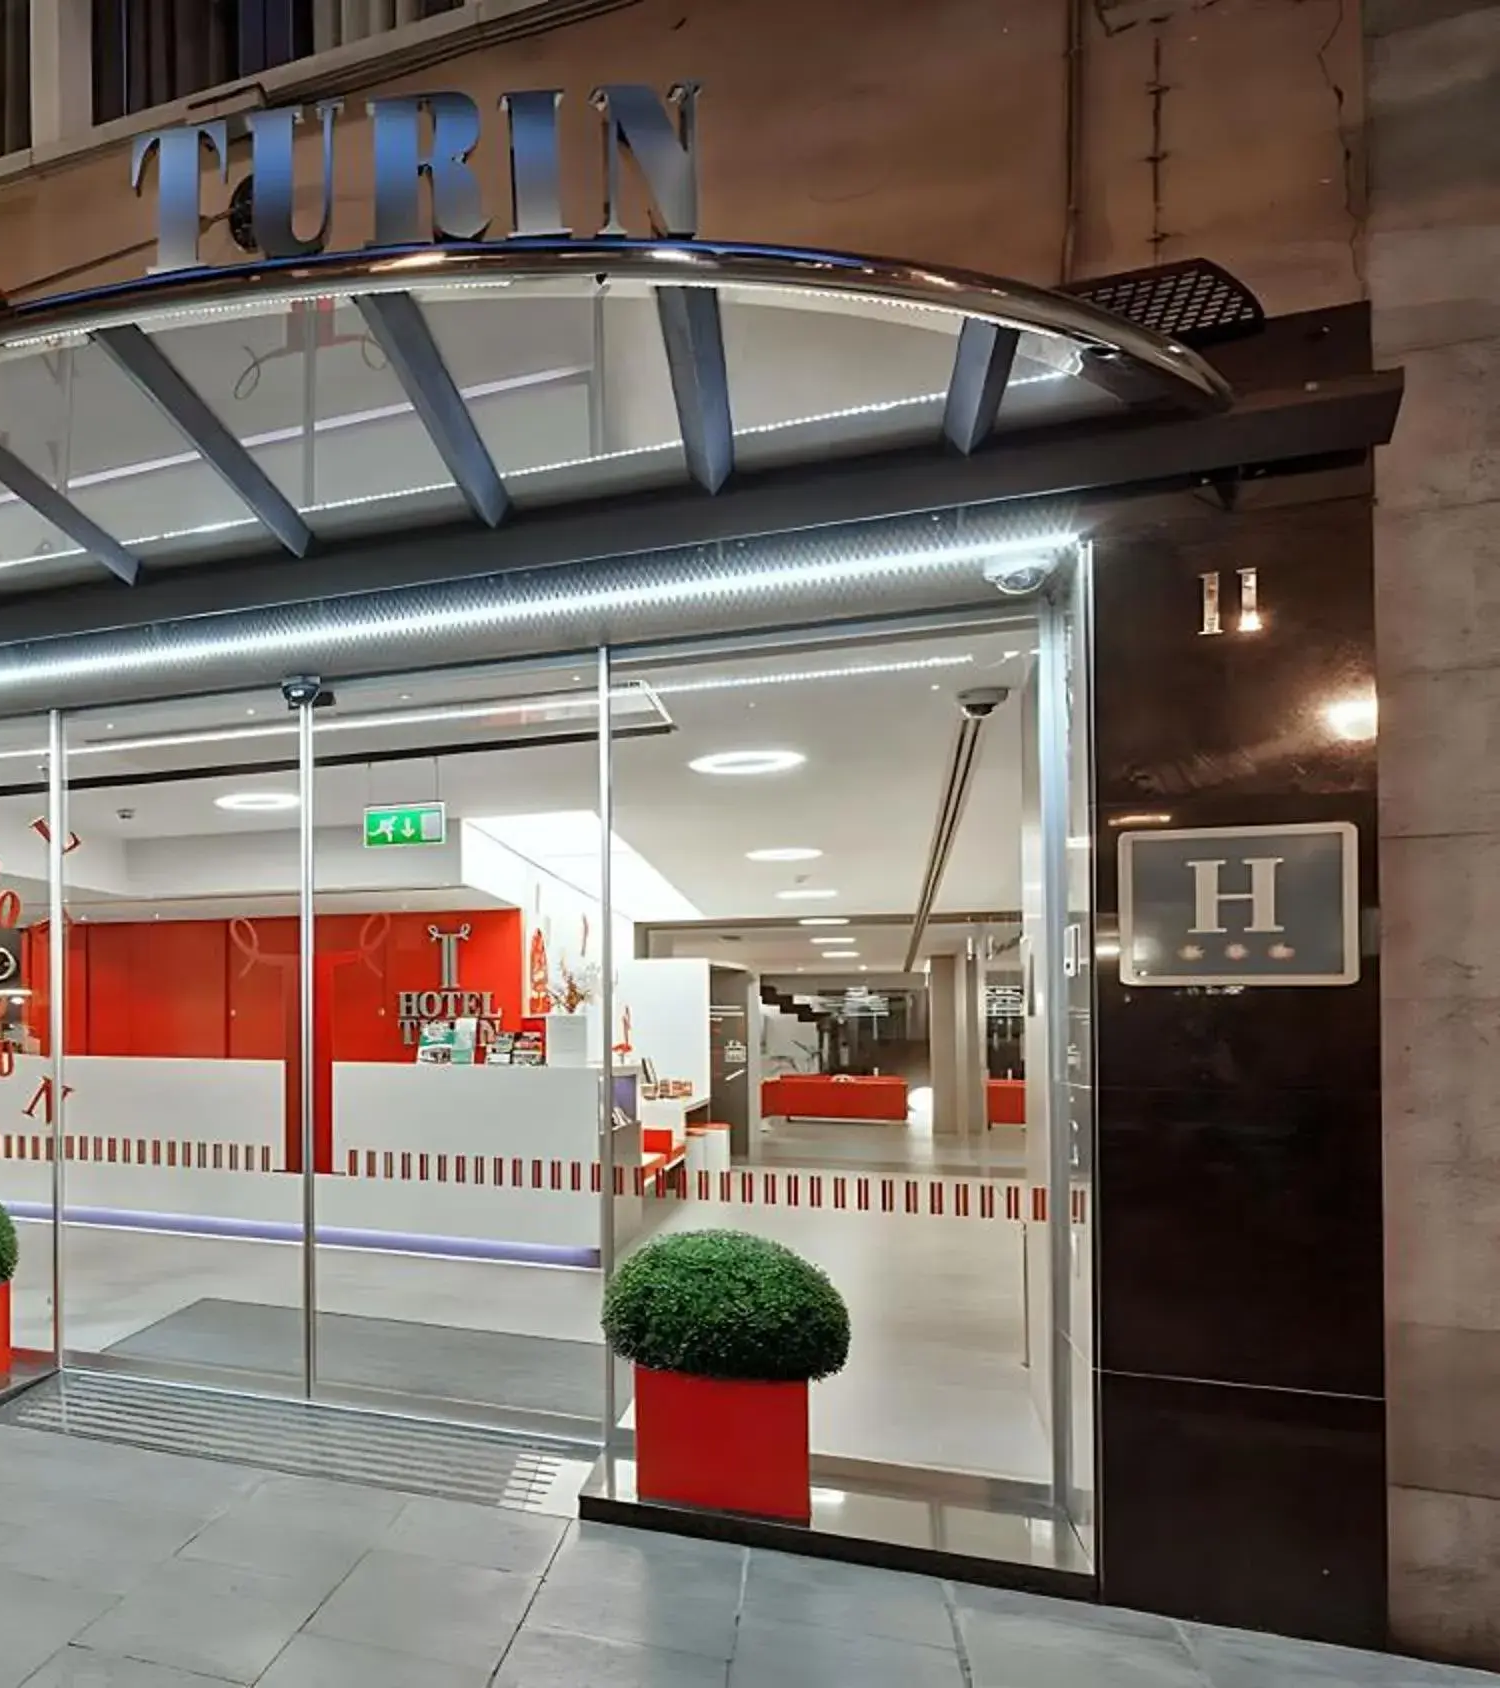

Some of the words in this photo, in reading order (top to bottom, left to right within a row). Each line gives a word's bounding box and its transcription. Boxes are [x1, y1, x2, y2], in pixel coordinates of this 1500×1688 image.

[131, 80, 700, 274] TURIN
[1185, 857, 1284, 933] H
[398, 991, 502, 1018] HOTEL
